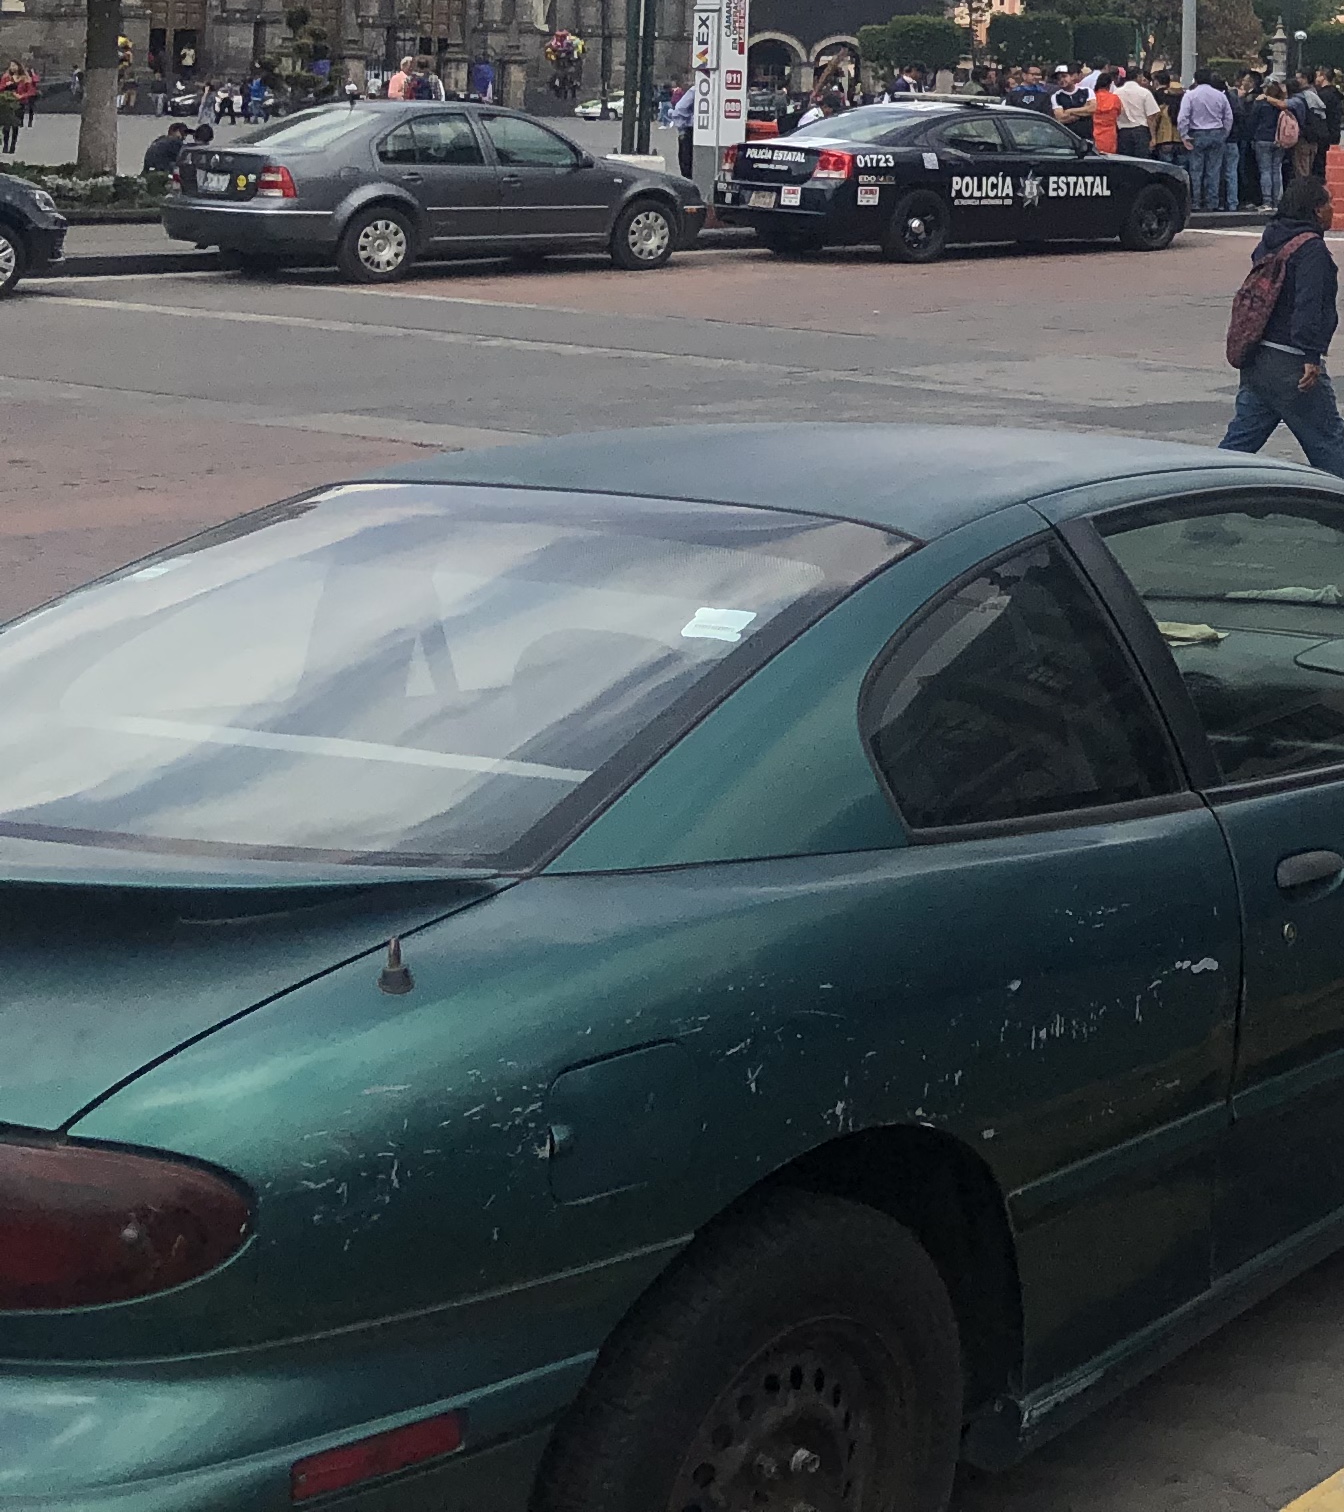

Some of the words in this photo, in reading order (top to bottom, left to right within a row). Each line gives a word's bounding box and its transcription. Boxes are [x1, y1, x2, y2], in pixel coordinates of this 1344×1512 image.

[731, 38, 738, 51] EN
[725, 73, 741, 84] 911
[746, 147, 772, 160] POLICÍA
[773, 149, 806, 163] ESTATAL
[856, 154, 895, 168] 01723
[951, 172, 1014, 198] POLICÍA
[1048, 175, 1111, 197] ESTATAL
